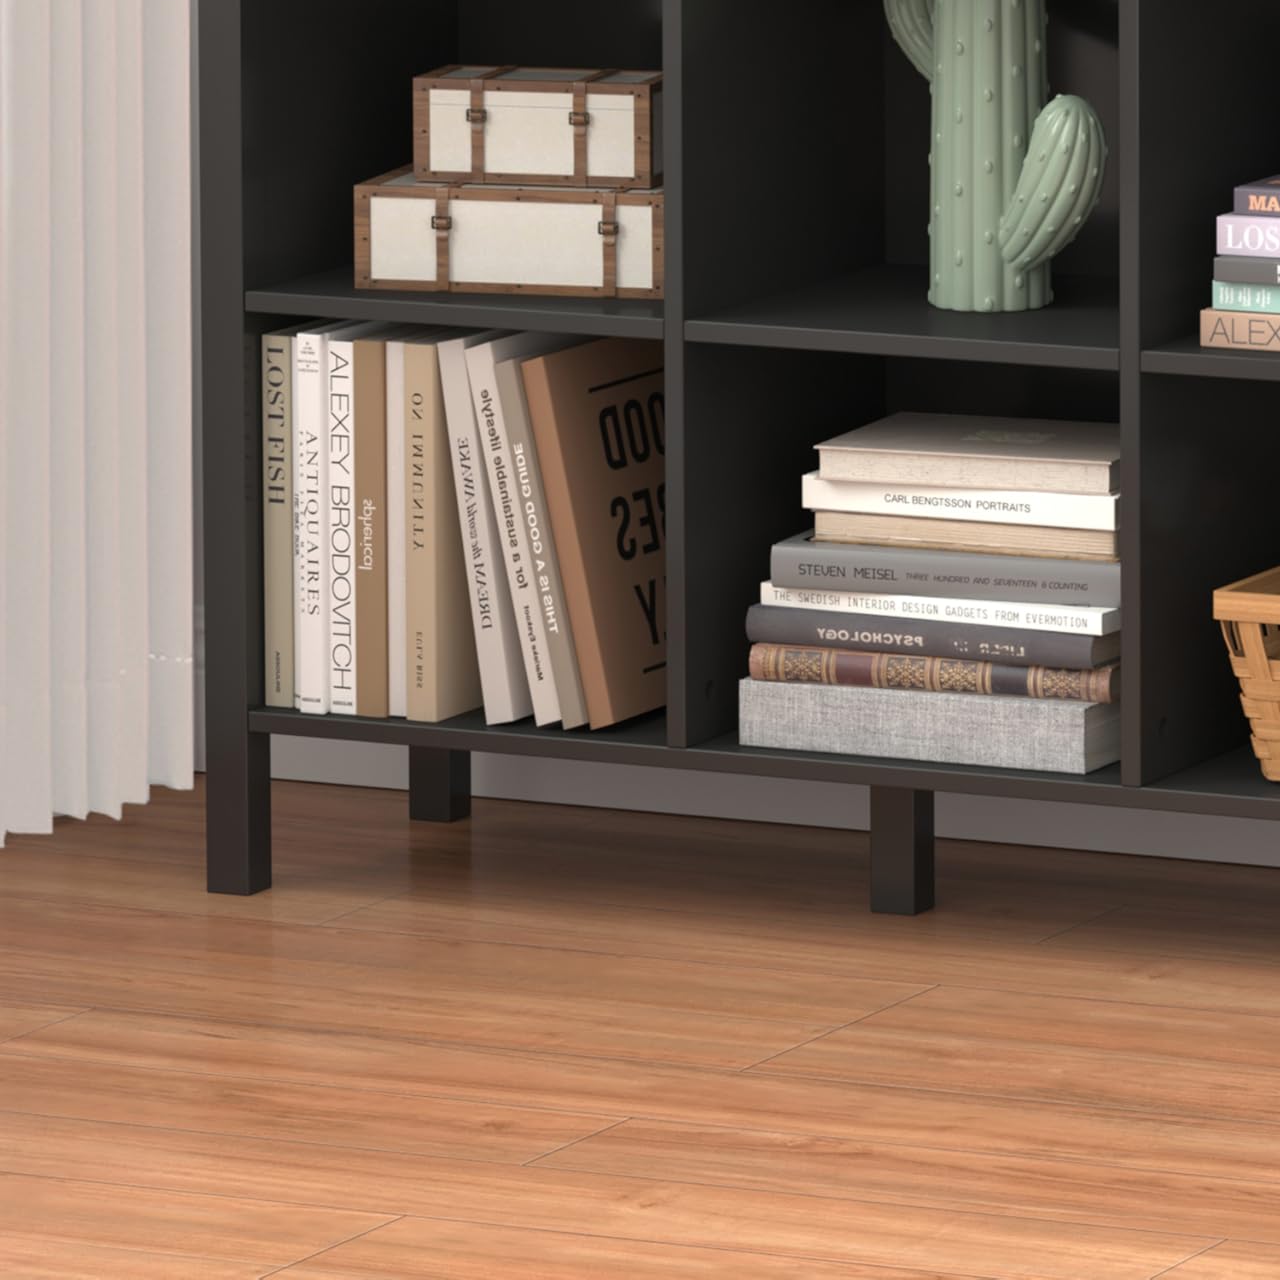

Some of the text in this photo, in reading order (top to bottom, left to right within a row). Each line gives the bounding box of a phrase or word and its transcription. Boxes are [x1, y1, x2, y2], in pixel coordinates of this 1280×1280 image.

[267, 348, 285, 504] LOST FISH
[330, 351, 350, 474] ALEXEY
[304, 431, 320, 616] ANTIQUAIRES
[884, 493, 1031, 513] CARL BENGTSSON PORTRAITS
[331, 485, 352, 690] BRODOVITCH
[773, 590, 1089, 628] THE SWEDISH INTERIOR DESIGN GADGETS FROM EVERMOTION
[798, 563, 846, 577] STEVEN
[854, 567, 898, 581] MEISEL
[933, 574, 970, 584] HUNDRED
[972, 577, 990, 585] AND
[993, 578, 1037, 588] SEVENTEEN
[1048, 581, 1089, 591] COUNTING
